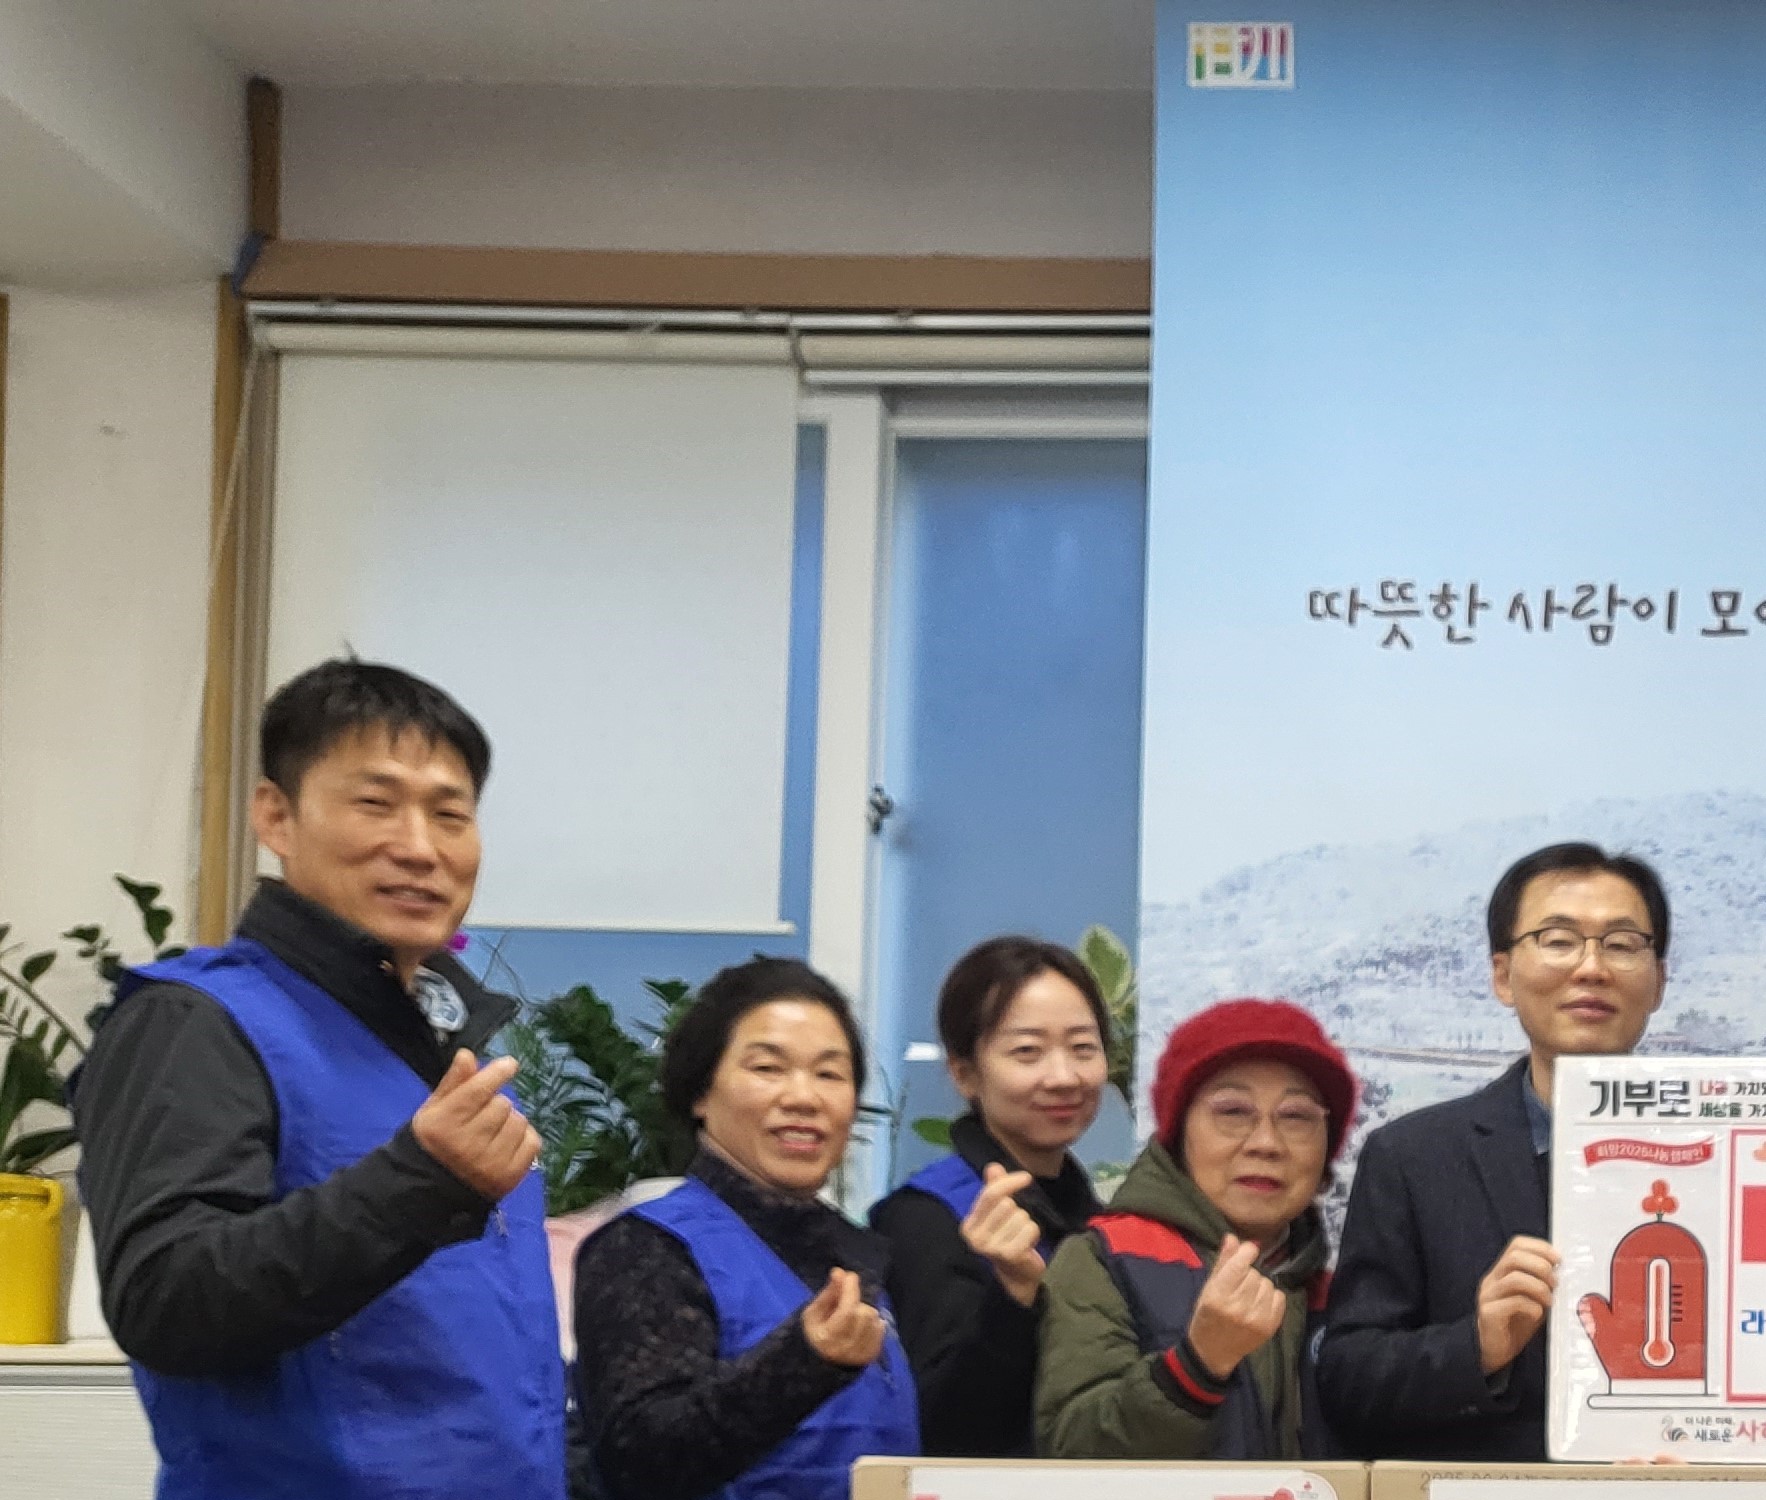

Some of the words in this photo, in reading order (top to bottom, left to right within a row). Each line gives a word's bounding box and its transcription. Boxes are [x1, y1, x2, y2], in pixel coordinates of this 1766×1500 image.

[1308, 580, 1490, 649] 따뜻한
[1508, 582, 1679, 646] 사람이
[1590, 1080, 1692, 1118] 기부로
